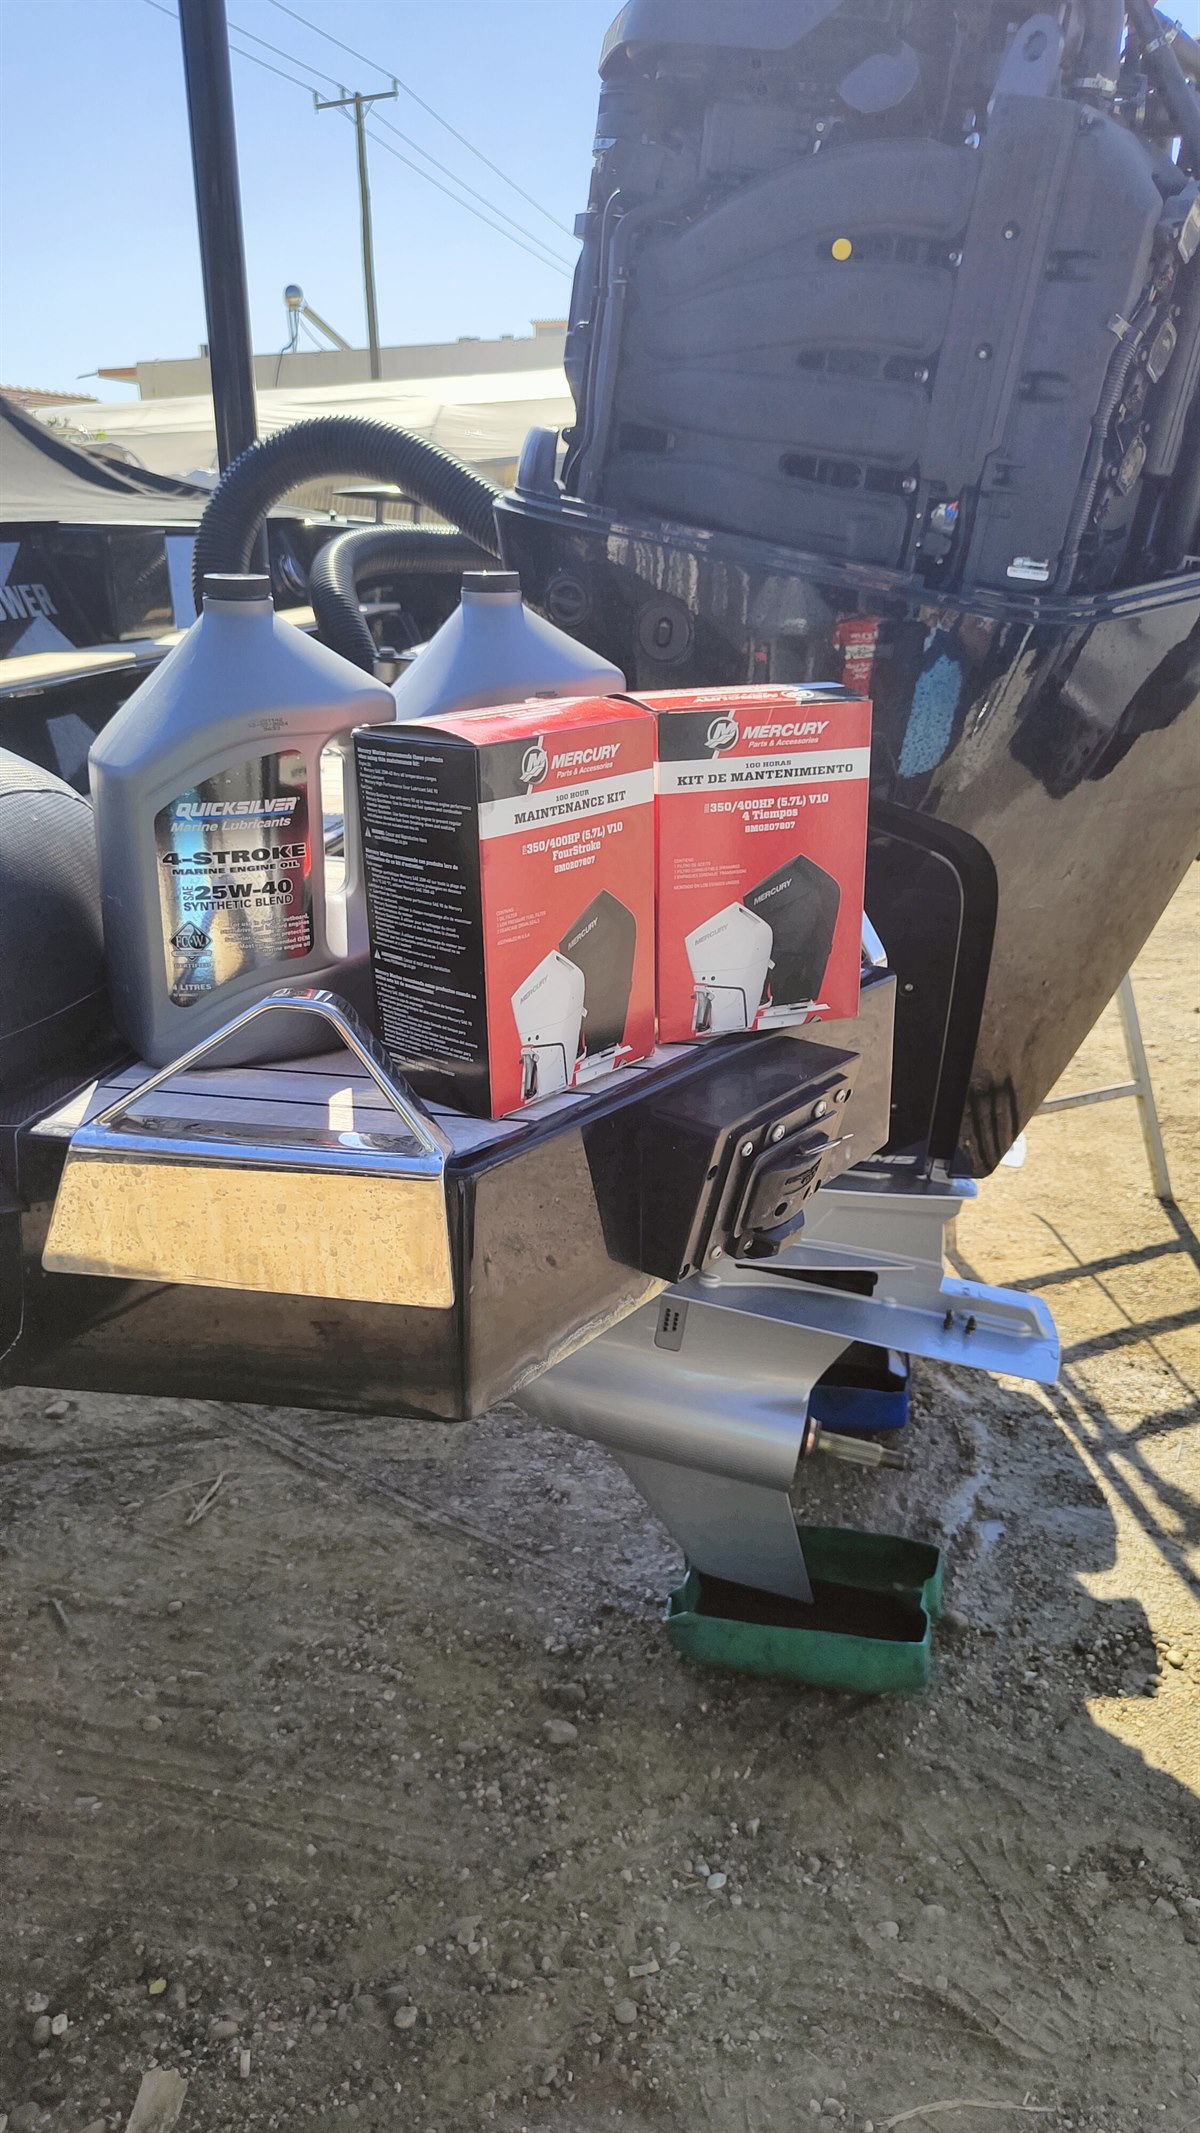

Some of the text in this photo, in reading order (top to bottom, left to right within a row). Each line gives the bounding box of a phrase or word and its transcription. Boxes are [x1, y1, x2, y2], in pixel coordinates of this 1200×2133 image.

[742, 720, 830, 740] MERCURY
[748, 740, 768, 748] Parts
[776, 737, 819, 746] Accessories
[551, 743, 620, 770] MERCURY
[762, 760, 792, 768] HORAS
[557, 768, 572, 778] Parts
[578, 761, 613, 774] Accessories
[677, 764, 854, 786] KIT DE MANTENIMIENTO
[556, 790, 590, 802] 100 HOUR
[710, 799, 775, 812] 350/400HP
[777, 796, 806, 809] (5.7L)
[808, 794, 828, 804] V10
[176, 797, 298, 820] QUICKSILVER
[514, 791, 626, 824] MAINTENANCE KIT
[742, 809, 798, 820] 4 Tiempos
[171, 816, 291, 833] Marine Lubricants
[526, 832, 580, 854] 350/400HP
[582, 826, 606, 842] (5.7L)
[607, 822, 623, 834] V10
[162, 843, 306, 866] 4-STROKE
[552, 841, 600, 861] FourStroke
[172, 861, 299, 876] MARINE ENGINE OIL
[182, 880, 293, 902] SAE 25W-40
[754, 878, 792, 906] MERCURY
[184, 894, 293, 912] SYNTHETIC BLEND
[568, 917, 598, 950] MERCURY
[694, 924, 729, 946] MERCURY
[520, 974, 549, 1005] MERCURY
